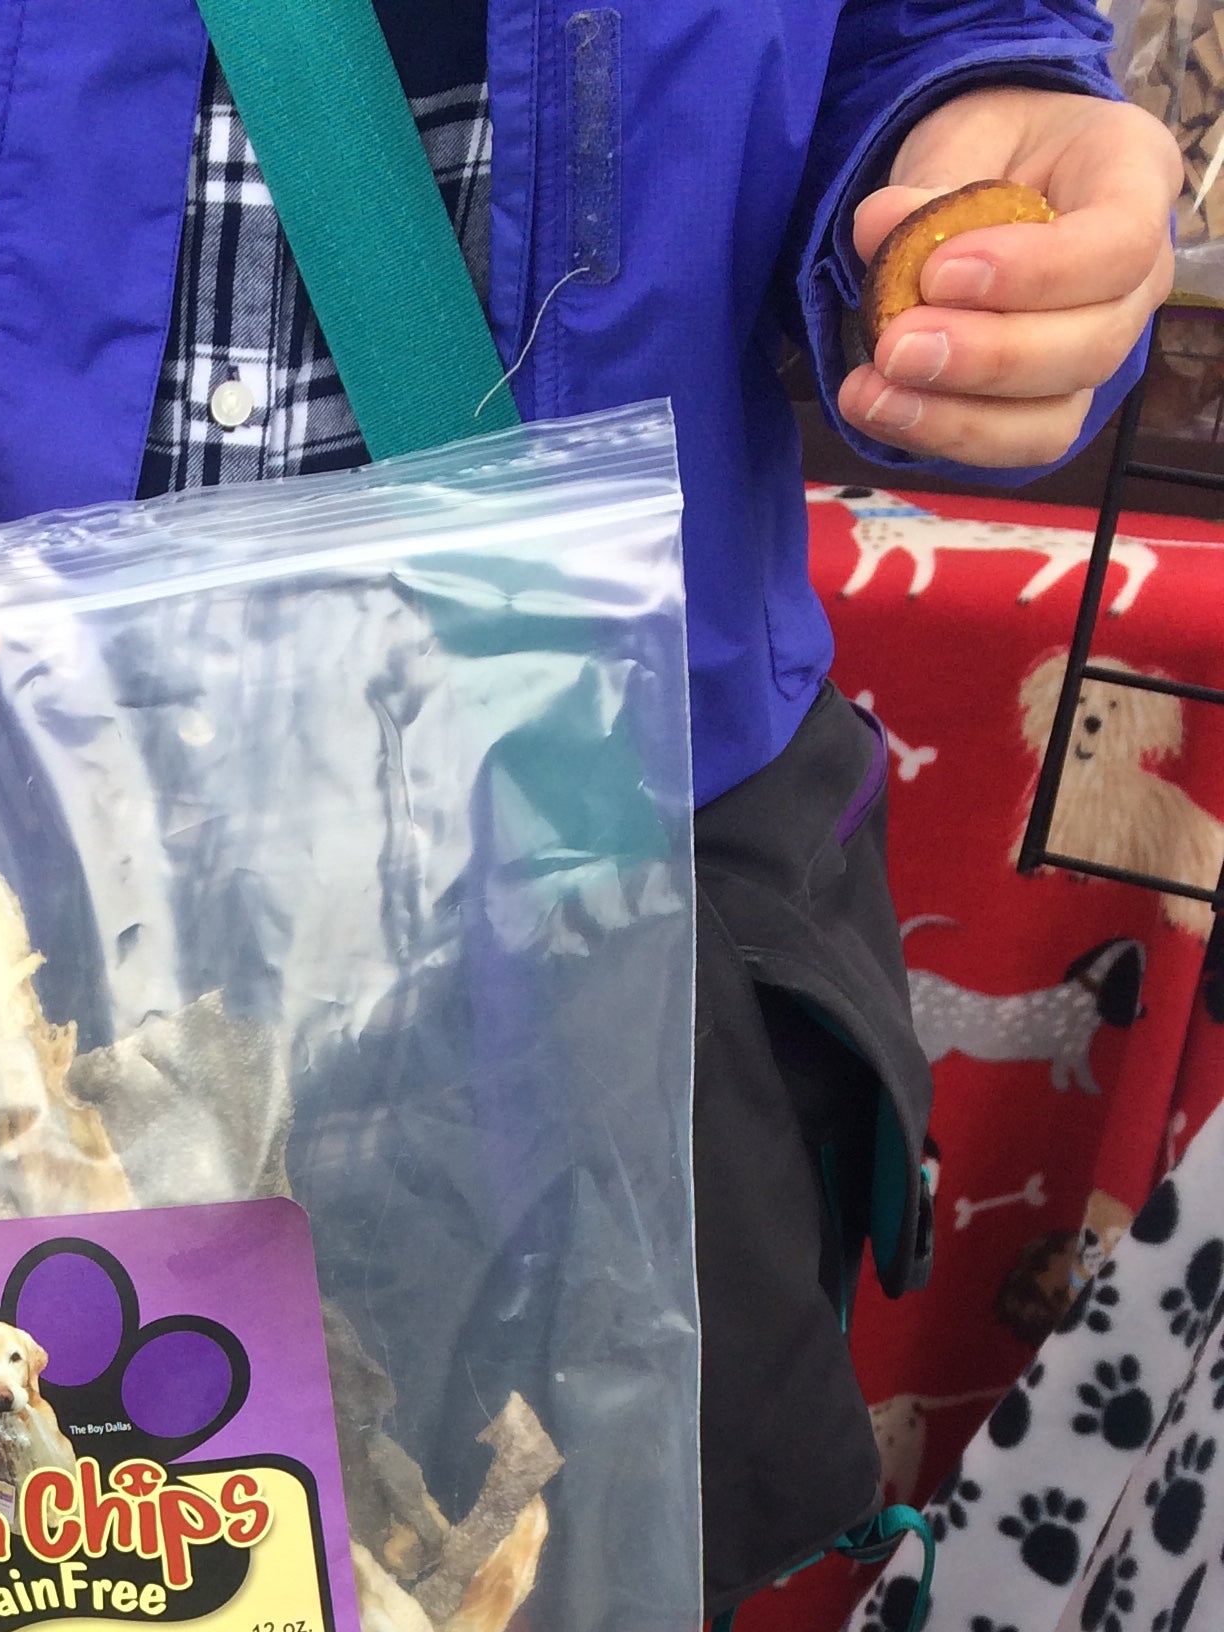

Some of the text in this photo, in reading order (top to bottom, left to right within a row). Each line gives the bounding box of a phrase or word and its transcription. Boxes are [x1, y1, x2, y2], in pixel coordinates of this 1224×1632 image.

[69, 1422, 132, 1435] The Boy Dallas
[24, 1460, 270, 1588] Chips
